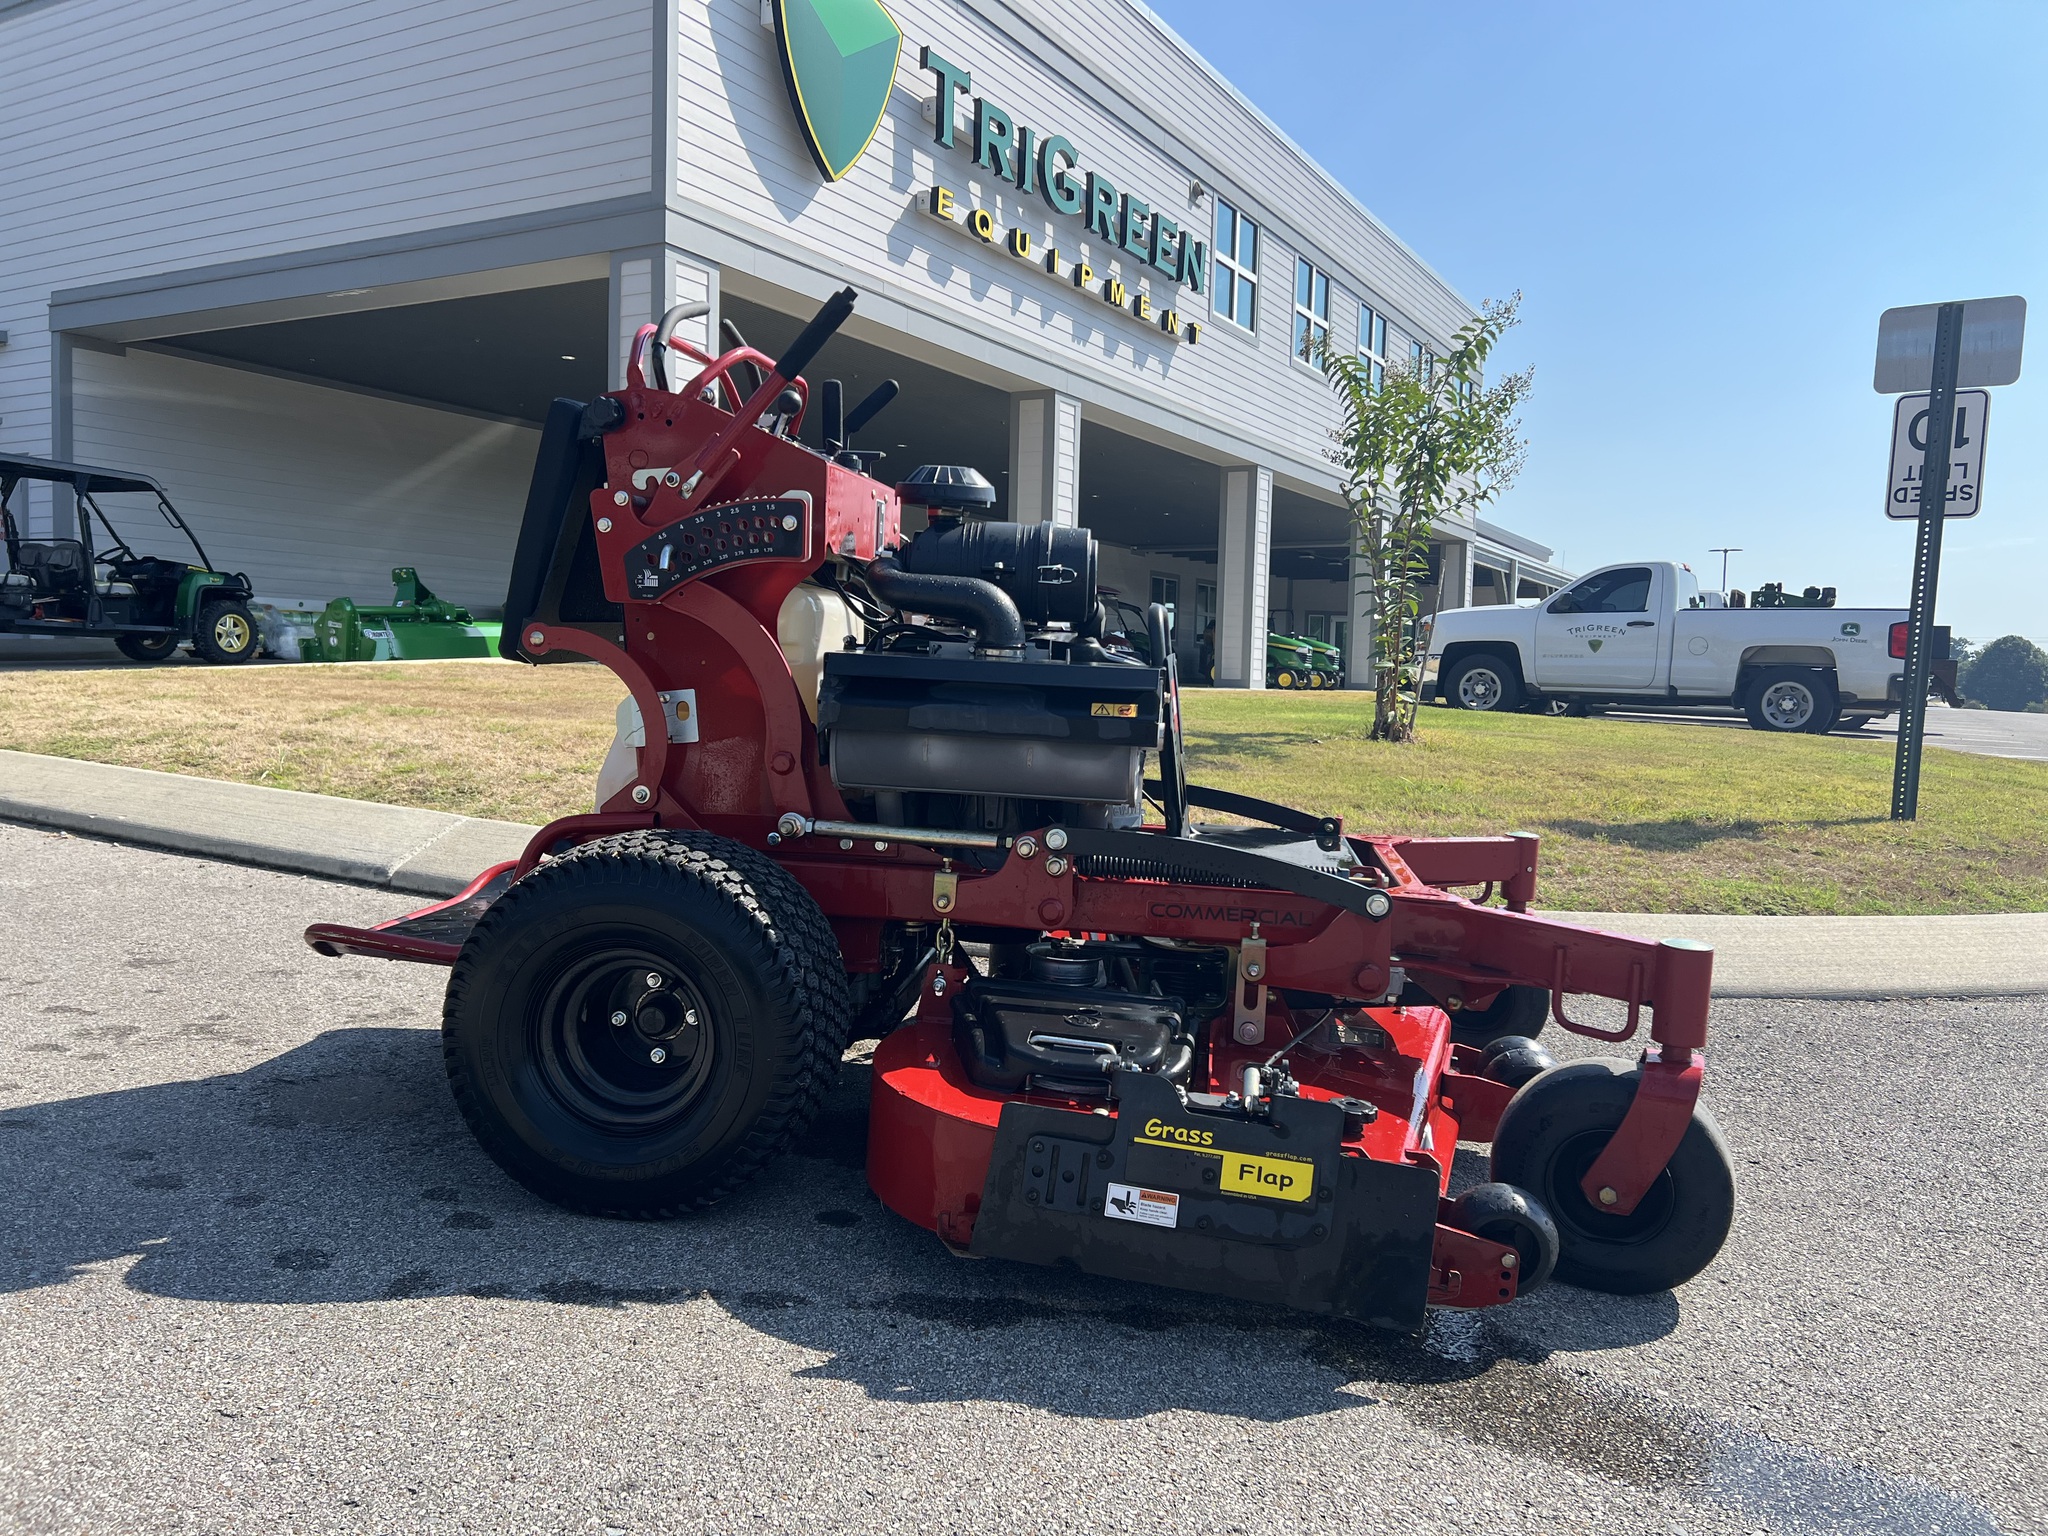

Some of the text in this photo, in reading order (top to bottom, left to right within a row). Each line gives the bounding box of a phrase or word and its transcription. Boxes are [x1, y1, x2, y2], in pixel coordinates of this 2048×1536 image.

[920, 45, 1207, 294] TRIGREEN
[930, 185, 1203, 345] EQUIPMENT
[1893, 484, 1974, 504] SPED
[658, 532, 667, 540] 4.5
[695, 516, 705, 524] 3.5
[730, 507, 740, 515] 2.5
[1566, 624, 1627, 636] TRIGREEN
[1150, 902, 1312, 926] COMMERCIAL
[1144, 1118, 1214, 1146] Grass
[1265, 1151, 1313, 1162] grassflap.com
[1239, 1163, 1294, 1191] Flap
[1147, 1193, 1176, 1203] WARNING
